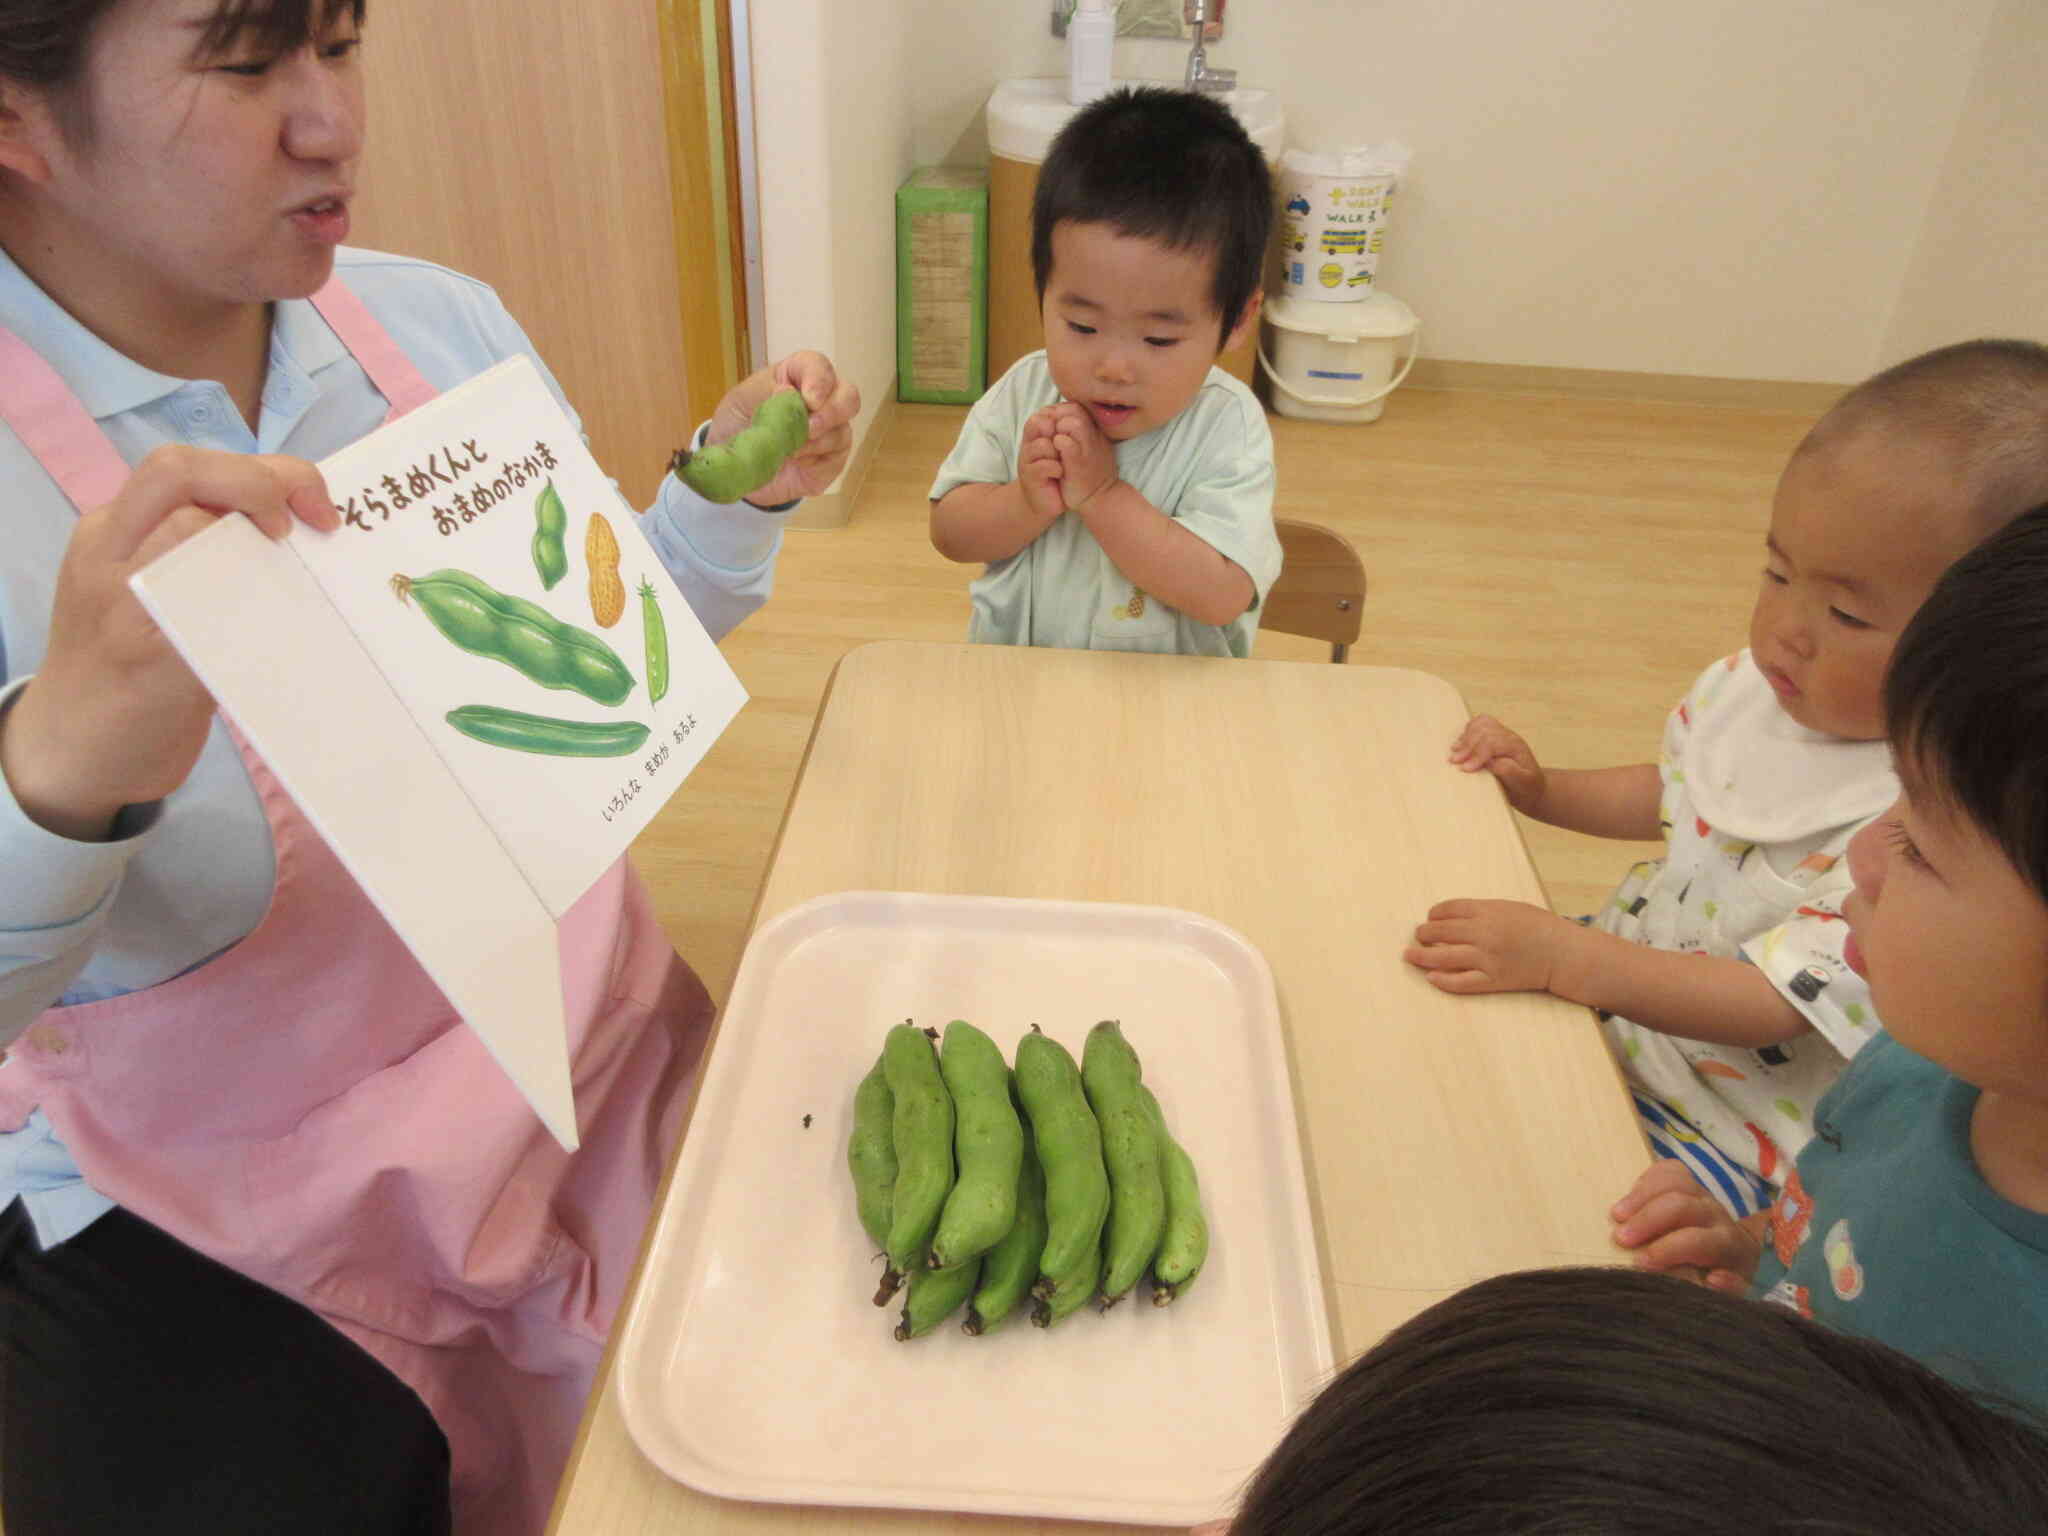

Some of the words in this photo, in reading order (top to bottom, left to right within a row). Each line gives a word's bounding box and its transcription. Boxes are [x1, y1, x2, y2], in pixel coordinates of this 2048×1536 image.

[1326, 213, 1363, 223] WALK
[335, 439, 488, 531] そらまめくんと
[432, 440, 558, 536] おまめのなかま
[602, 778, 642, 821] いろんな
[644, 744, 670, 776] まめが
[673, 714, 697, 744] あるよ
